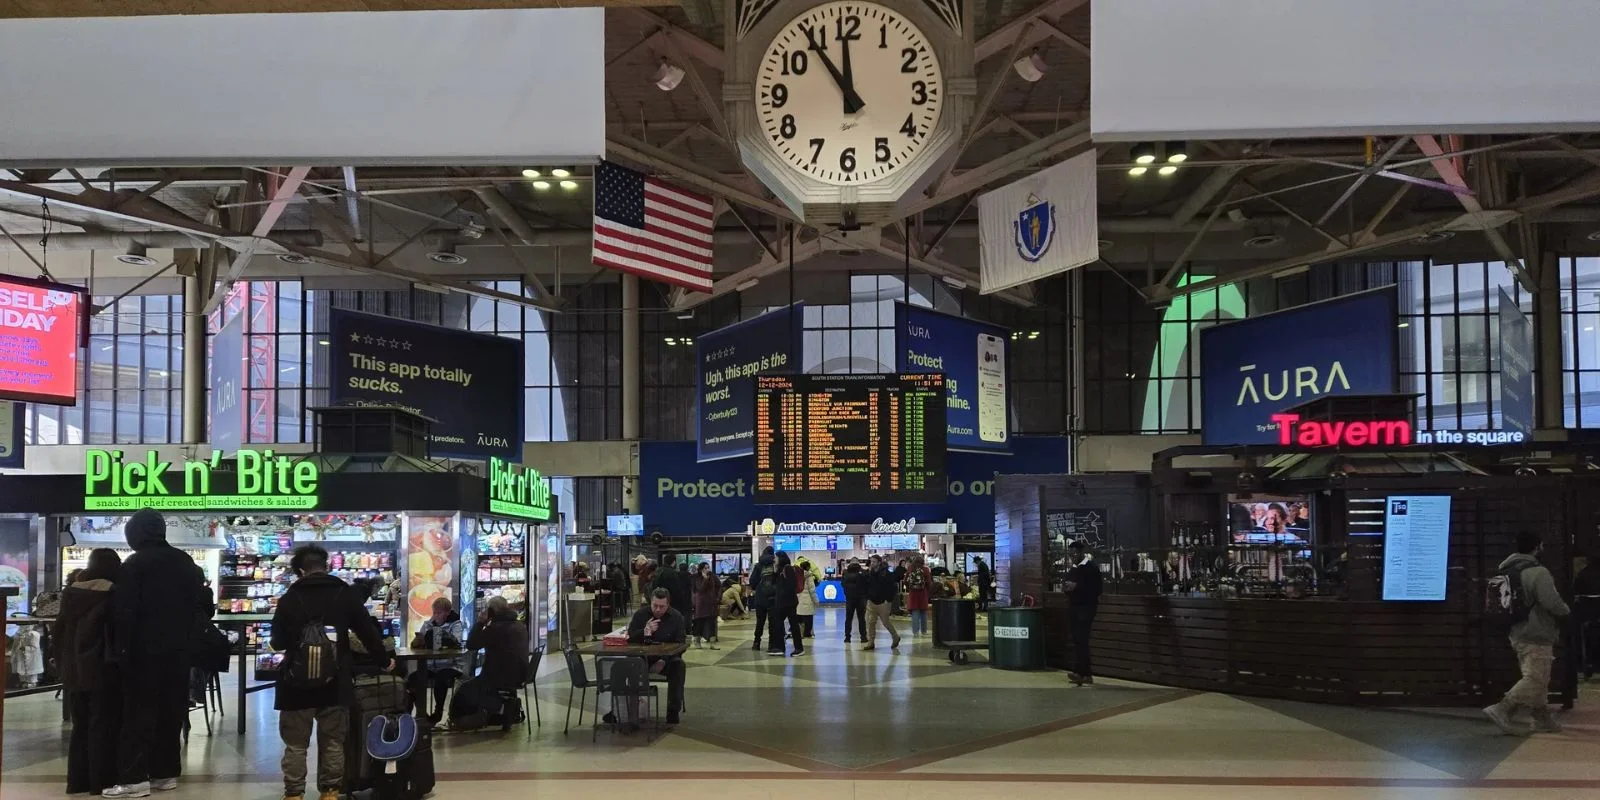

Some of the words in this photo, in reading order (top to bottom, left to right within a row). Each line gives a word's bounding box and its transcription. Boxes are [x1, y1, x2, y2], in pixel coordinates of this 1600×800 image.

[808, 25, 827, 50] 11
[835, 16, 861, 40] 12
[878, 25, 888, 48] 1
[781, 50, 807, 75] 10
[901, 48, 917, 72] 2
[772, 84, 788, 108] 9
[912, 81, 927, 104] 3
[780, 114, 796, 138] 8
[900, 113, 916, 137] 4
[810, 138, 825, 163] 7
[840, 148, 856, 172] 6
[875, 138, 891, 162] 5
[349, 353, 385, 372] This
[389, 362, 420, 379] app
[424, 364, 472, 386] totally
[706, 372, 723, 386] Ugh,
[725, 364, 740, 378] this
[742, 362, 759, 376] app
[761, 356, 769, 370] is
[771, 352, 786, 368] the
[909, 350, 943, 369] Protect
[349, 376, 403, 394] sucks.
[706, 386, 730, 403] worst.
[947, 395, 970, 410] nline.
[1270, 413, 1410, 445] Tavern
[1416, 430, 1431, 443] in
[1435, 430, 1462, 444] the
[1467, 430, 1524, 445] square
[86, 449, 172, 495] Pick
[238, 449, 318, 494] Bite
[490, 457, 515, 502] Pick
[530, 469, 549, 508] Bite
[658, 478, 745, 497] Protect
[96, 498, 129, 507] snacks
[143, 498, 164, 507] chef
[167, 498, 203, 507] created
[207, 497, 264, 506] sandwiches
[276, 496, 307, 506] salads
